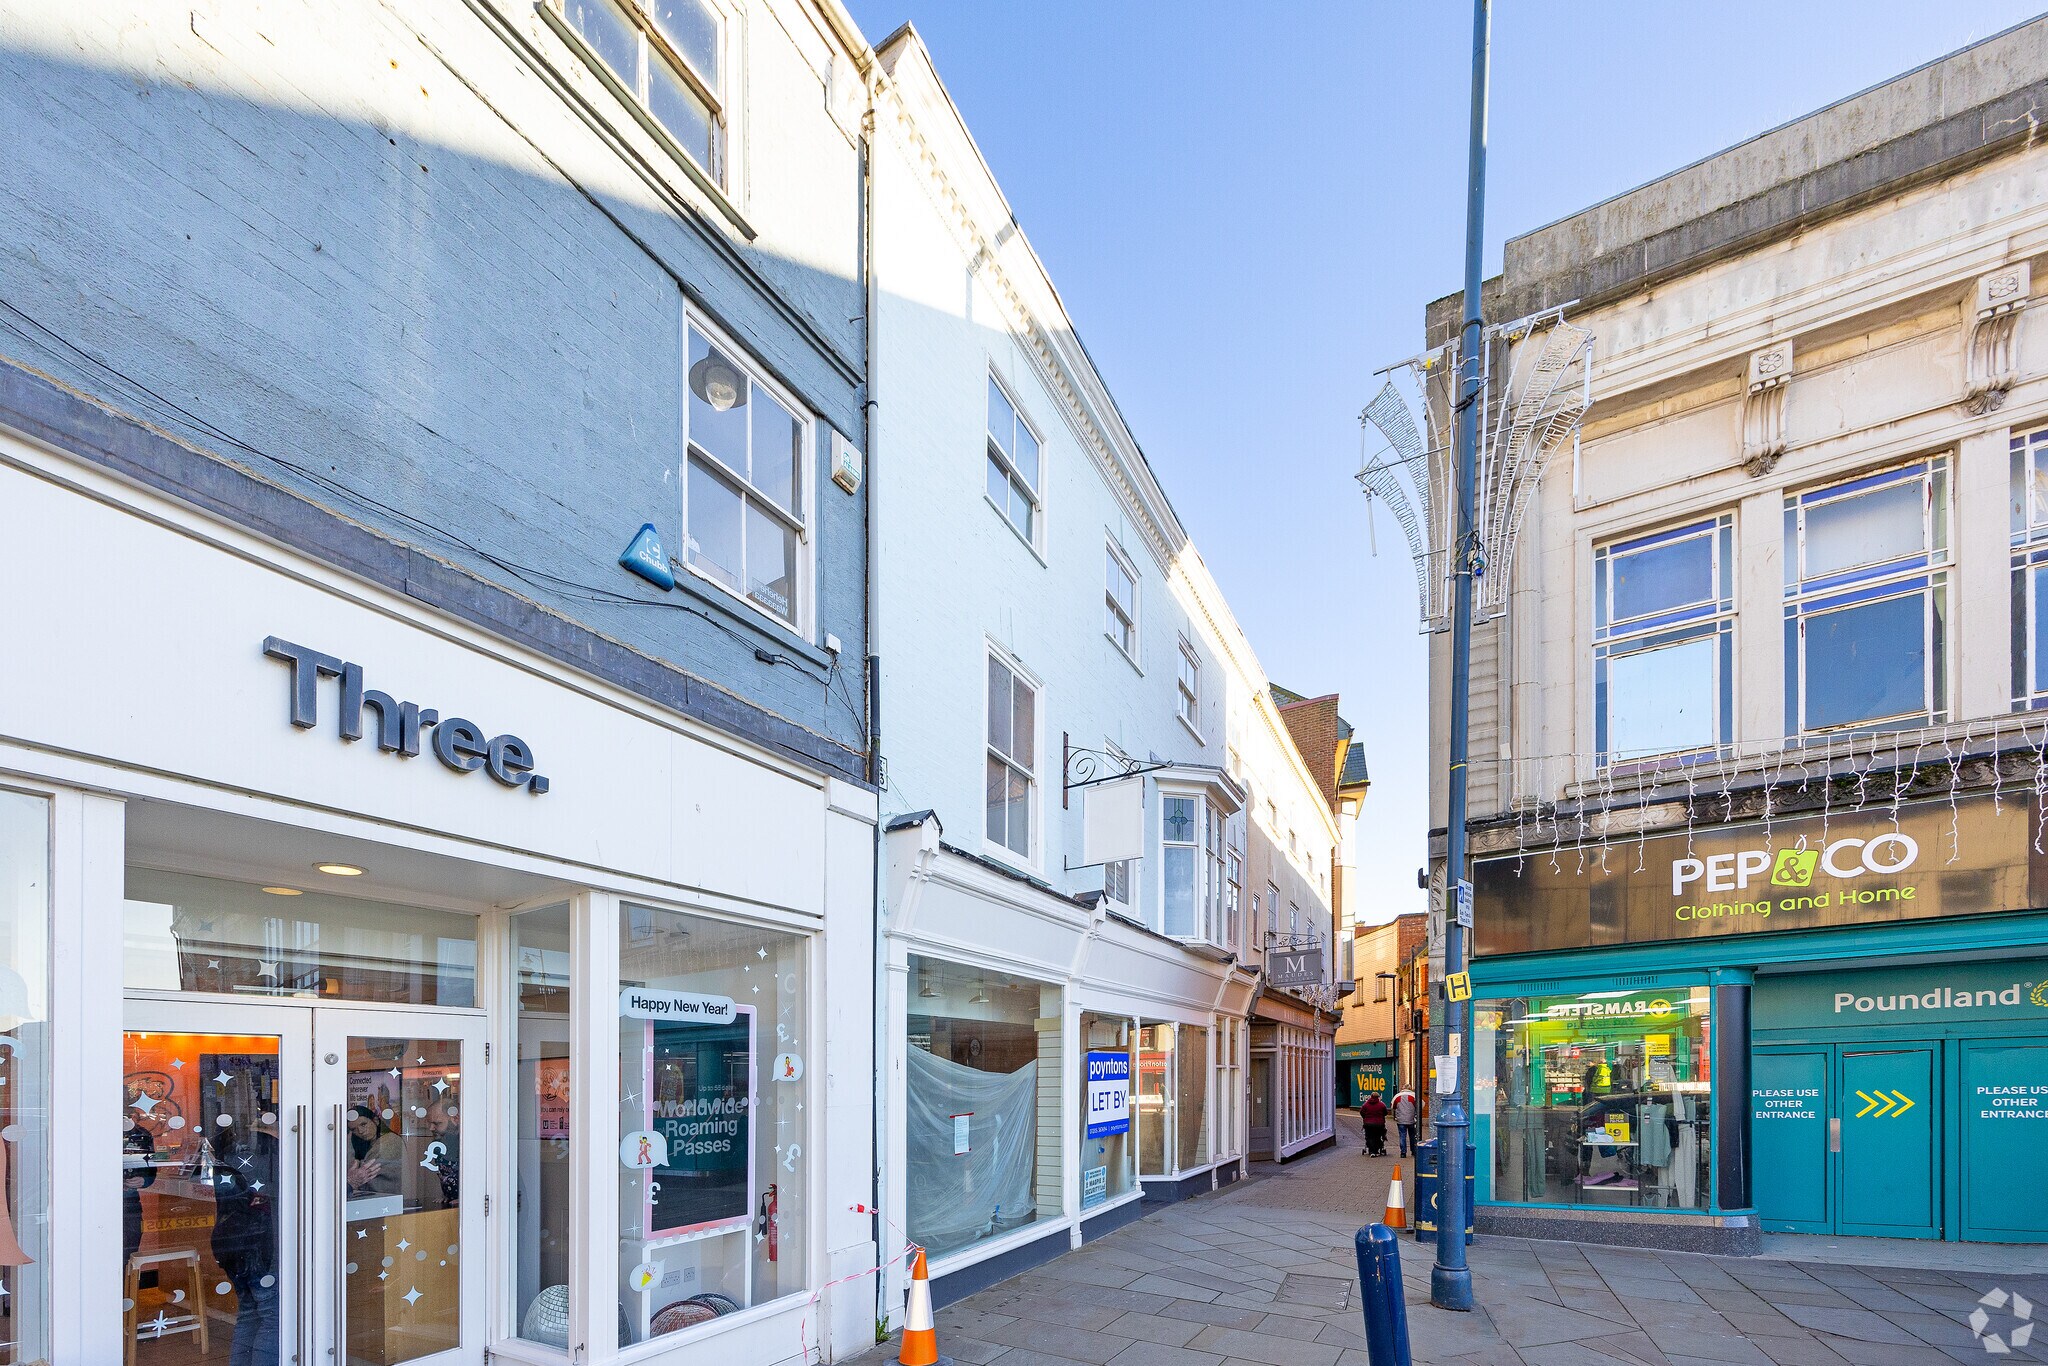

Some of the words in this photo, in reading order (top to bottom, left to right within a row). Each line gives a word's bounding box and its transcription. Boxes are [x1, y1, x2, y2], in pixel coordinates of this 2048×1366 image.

[640, 551, 668, 574] Chubb
[1675, 899, 1771, 921] Clothing
[1779, 892, 1830, 911] and
[1839, 886, 1916, 905] Home
[1284, 955, 1306, 974] M
[1277, 971, 1314, 979] MAUDES
[1450, 974, 1469, 998] H
[631, 996, 671, 1013] Happy
[674, 999, 699, 1013] New
[702, 1001, 728, 1015] Year!
[1834, 983, 2020, 1013] Poundland
[1090, 1058, 1128, 1079] poyntons
[1360, 1063, 1382, 1074] Amazing
[350, 1077, 372, 1085] Connected
[1357, 1074, 1386, 1091] Value
[1752, 1089, 1794, 1097] PLEASE
[1796, 1089, 1819, 1097] USE
[1977, 1086, 2026, 1095] PLEASE
[2028, 1086, 2048, 1094] US
[657, 1097, 744, 1118] Worldwide
[1092, 1091, 1111, 1111] LET
[1113, 1090, 1127, 1109] BY
[1765, 1100, 1803, 1108] OTHER
[1992, 1098, 2038, 1106] OTHER
[1755, 1111, 1815, 1119] ENTRANCE
[665, 1118, 738, 1137] Roaming
[673, 1139, 731, 1157] Passes
